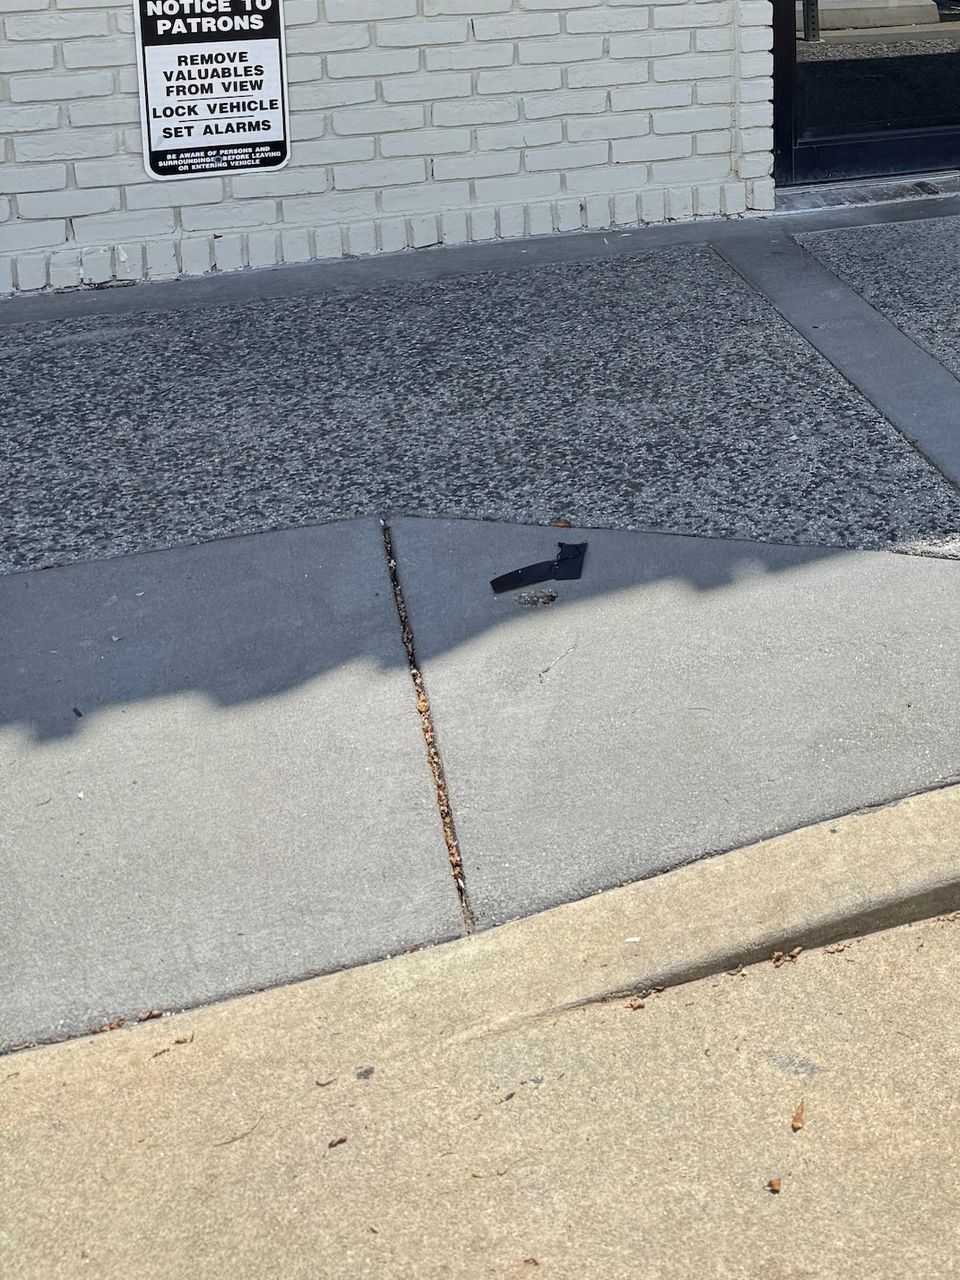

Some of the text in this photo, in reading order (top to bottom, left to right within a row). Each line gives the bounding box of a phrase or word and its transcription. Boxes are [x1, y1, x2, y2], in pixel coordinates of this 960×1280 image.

[157, 14, 264, 35] PATRONS
[177, 51, 249, 66] REMOVE
[163, 65, 264, 81] VALUABLES
[166, 80, 264, 96] FROM VIEW
[152, 99, 279, 119] LOCK VEHICLE
[162, 120, 272, 139] SET ALARMS
[179, 151, 205, 159] AWARE
[220, 147, 253, 155] PERSONS
[191, 162, 228, 170] ENTERING
